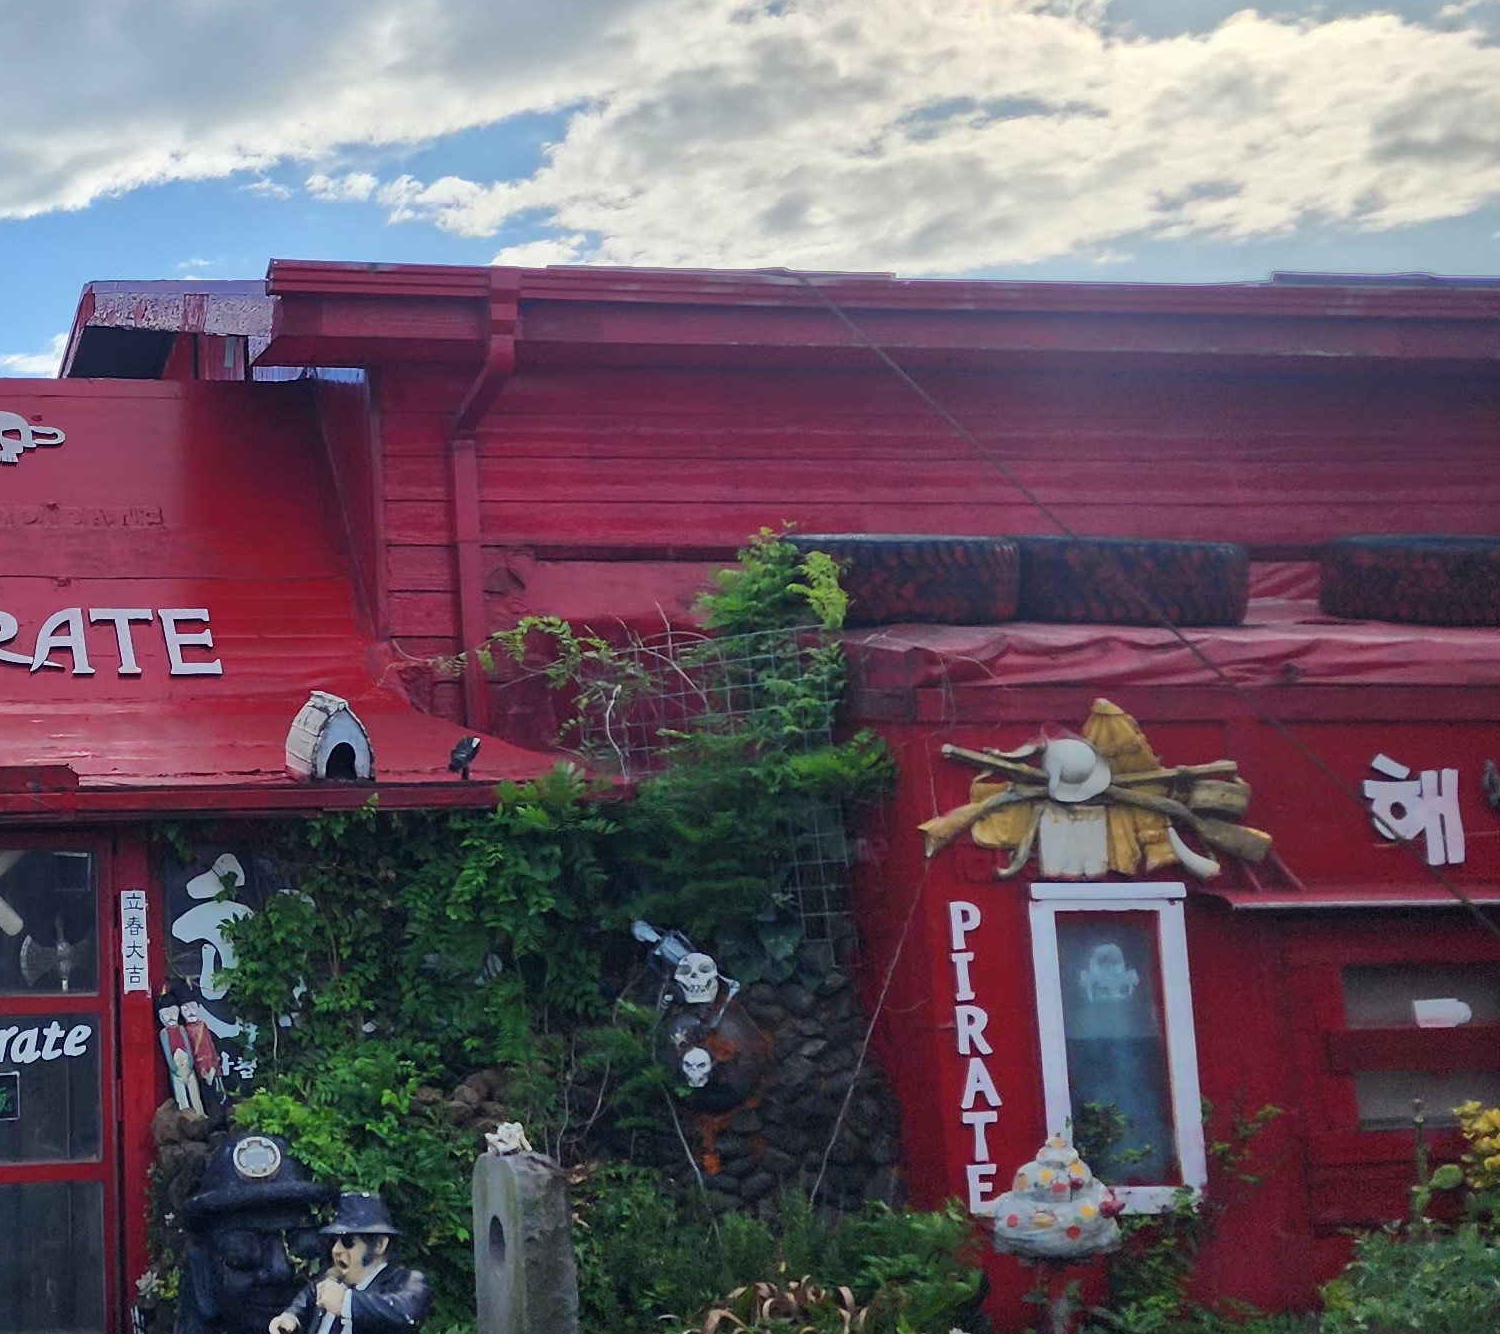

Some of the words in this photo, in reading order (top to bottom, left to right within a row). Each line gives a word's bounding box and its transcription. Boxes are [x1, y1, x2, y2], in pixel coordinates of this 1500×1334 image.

[1363, 752, 1466, 867] 해
[123, 892, 145, 984] 立春大吉
[948, 900, 1003, 1215] PIRATE
